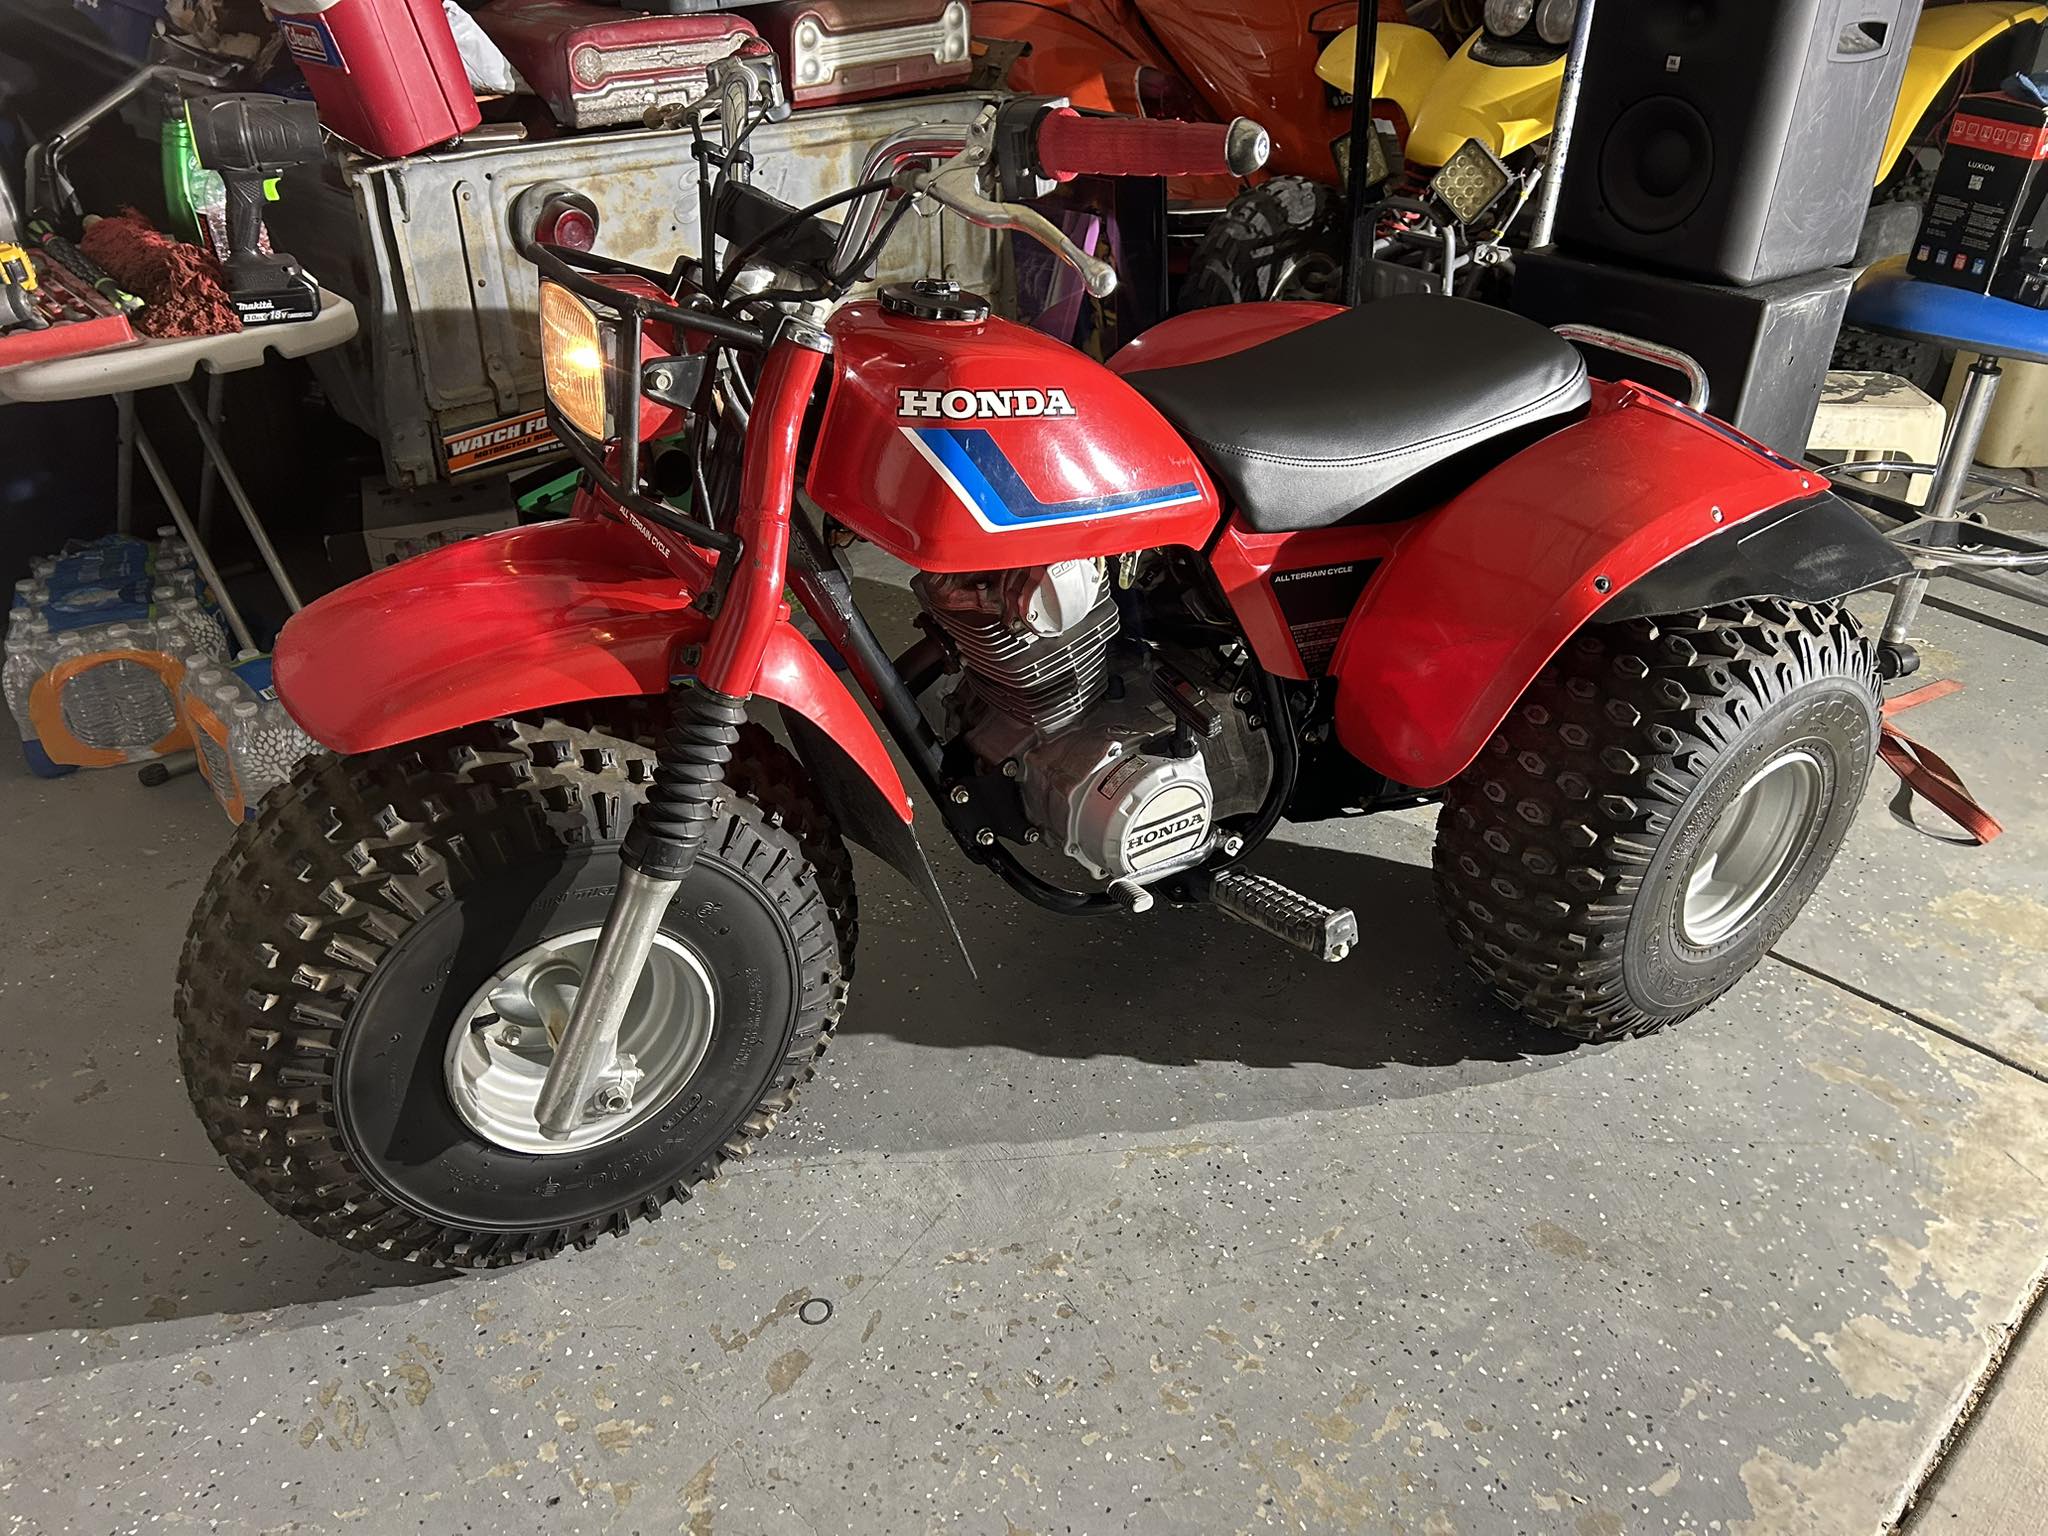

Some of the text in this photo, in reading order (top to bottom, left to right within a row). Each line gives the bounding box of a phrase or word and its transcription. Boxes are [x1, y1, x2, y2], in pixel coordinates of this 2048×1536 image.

[1968, 161, 1995, 172] LUXION
[898, 389, 1076, 419] HONDA
[451, 416, 548, 456] WATCH FO
[619, 505, 671, 559] ALL TERRAIN CYCLE
[1274, 565, 1354, 583] ALL TERRAIN CYCLE
[1127, 813, 1205, 850] HONDA
